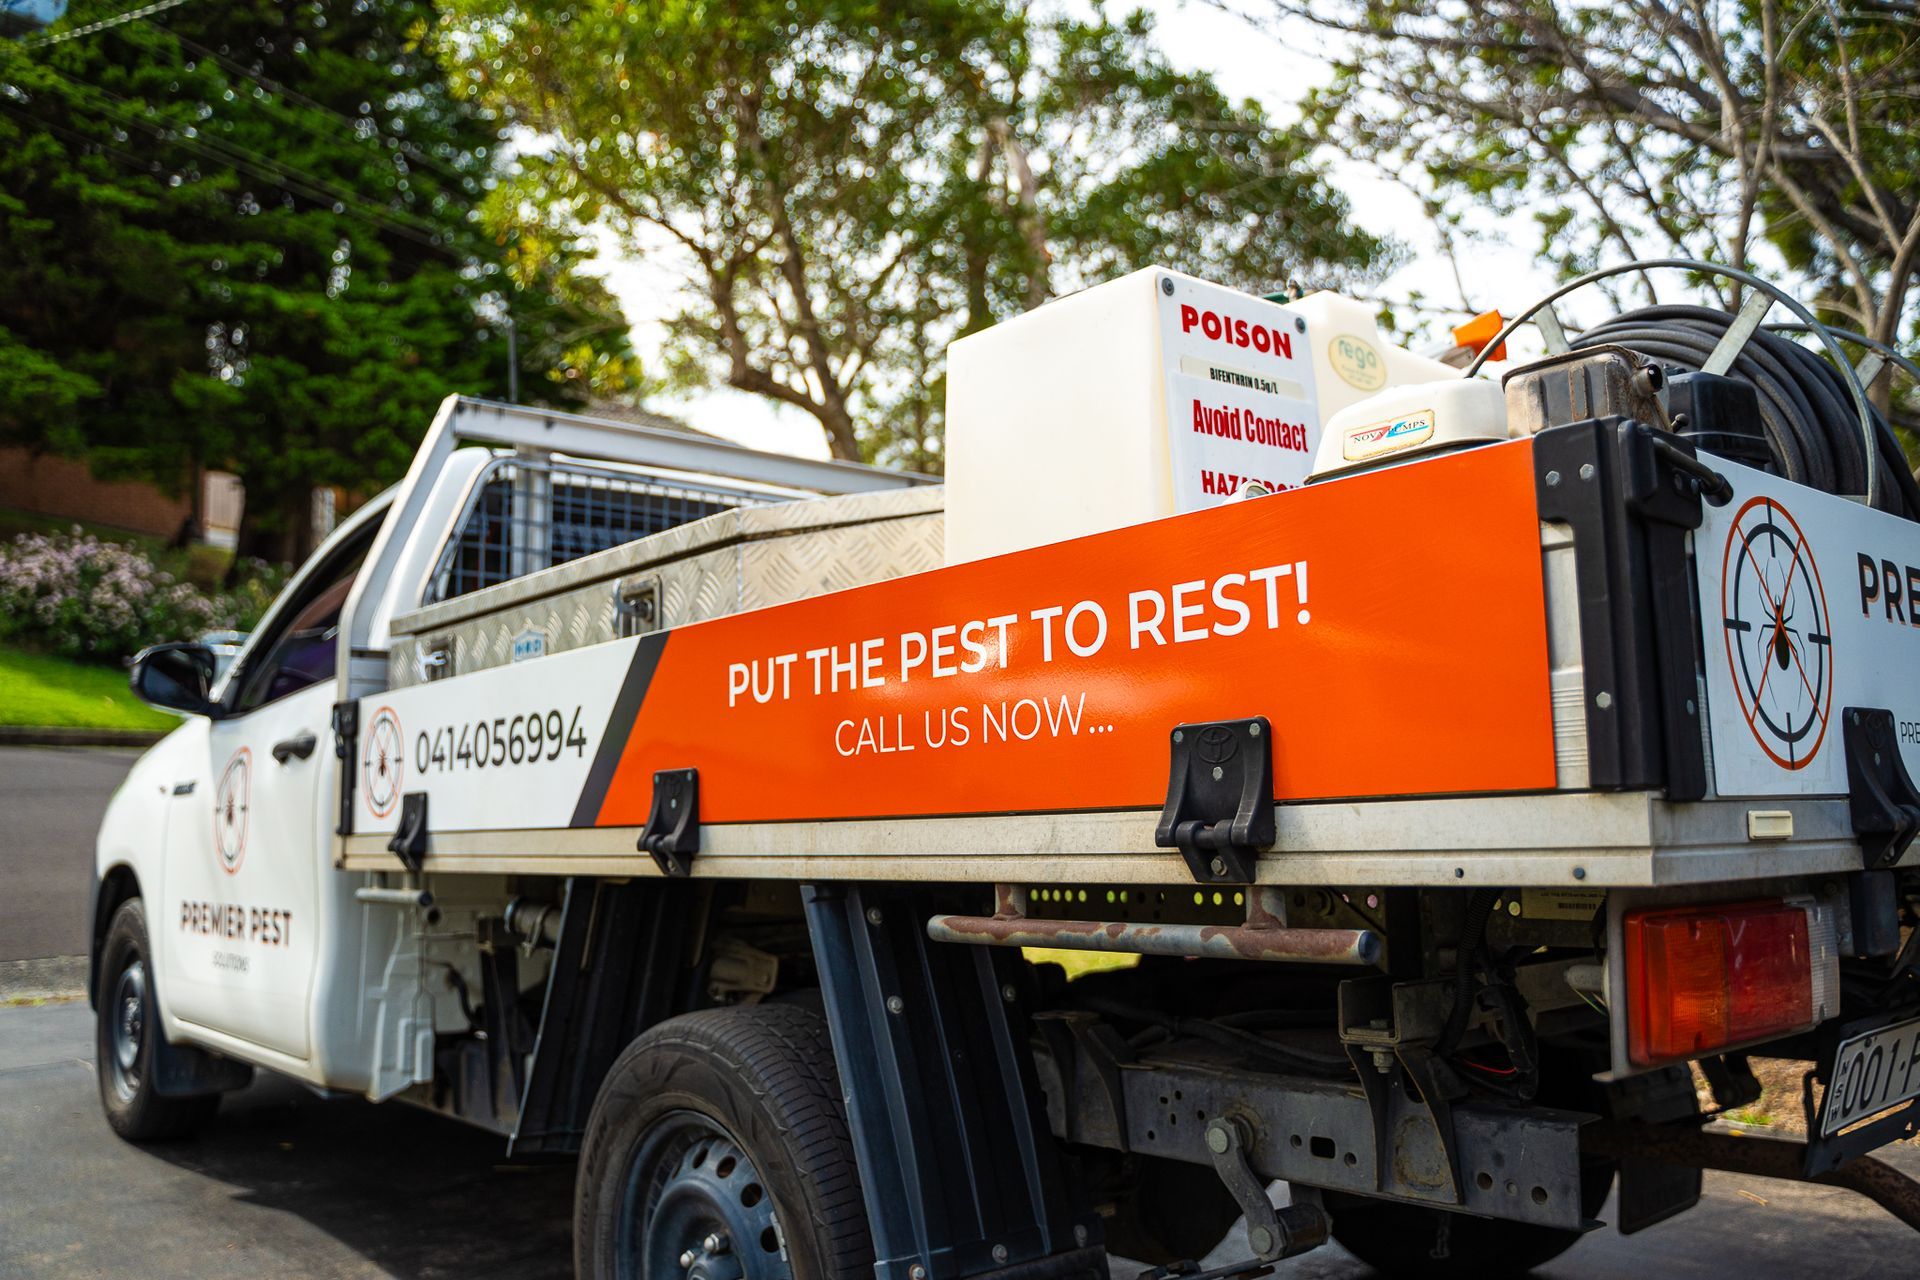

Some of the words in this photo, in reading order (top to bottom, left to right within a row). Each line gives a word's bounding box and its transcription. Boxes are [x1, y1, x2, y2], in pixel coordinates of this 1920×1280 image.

[1181, 304, 1293, 360] POISON
[1338, 339, 1377, 369] rega
[1210, 367, 1253, 389] BIFENTHRIN
[1193, 399, 1242, 441] Avoid
[1244, 409, 1309, 453] Contact
[729, 653, 798, 707] PUT
[806, 638, 885, 695] THE
[901, 614, 1018, 683] PEST
[1030, 605, 1108, 662] TO
[1128, 560, 1311, 649] REST!
[416, 705, 587, 775] 0414056994
[835, 713, 915, 756] CALL
[925, 706, 970, 748] US
[983, 692, 1114, 744] NOW...
[181, 899, 246, 941] PREMIER
[251, 906, 293, 949] PEST
